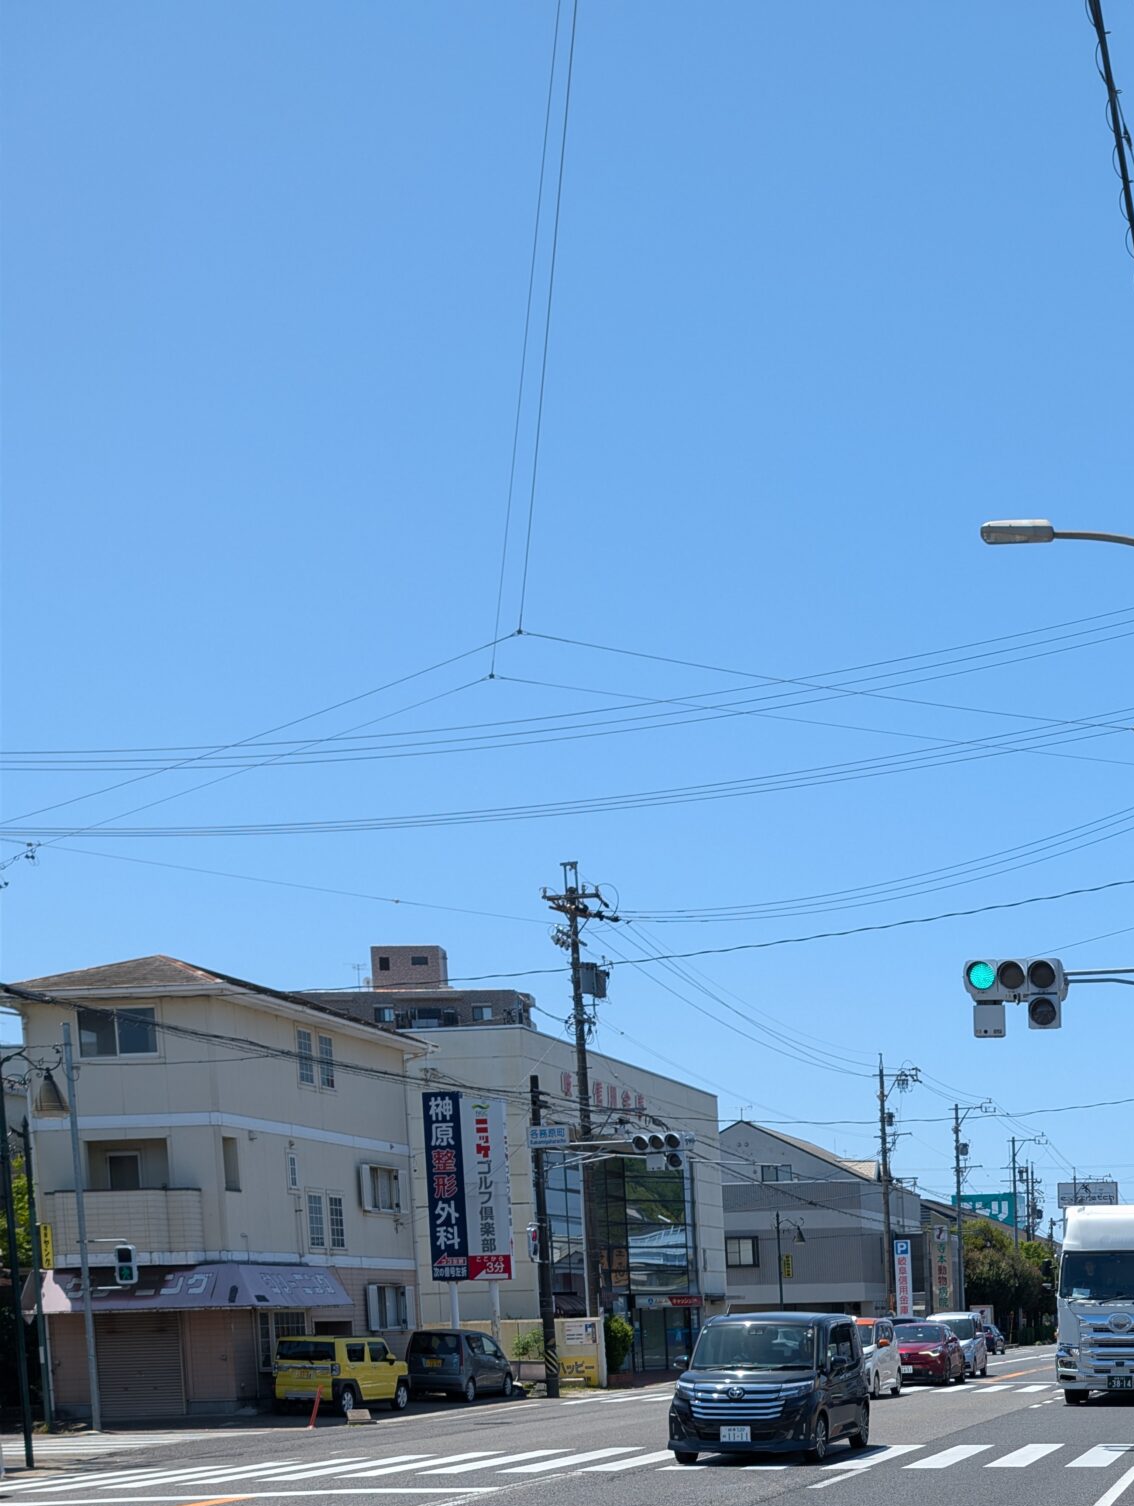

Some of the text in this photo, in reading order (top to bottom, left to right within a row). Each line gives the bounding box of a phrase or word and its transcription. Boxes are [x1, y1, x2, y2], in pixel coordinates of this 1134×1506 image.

[428, 1096, 461, 1251] 榊原整形外科
[475, 1118, 497, 1253] ニッケゴルフ倶楽部
[486, 1261, 505, 1273] 3分
[897, 1242, 907, 1254] P
